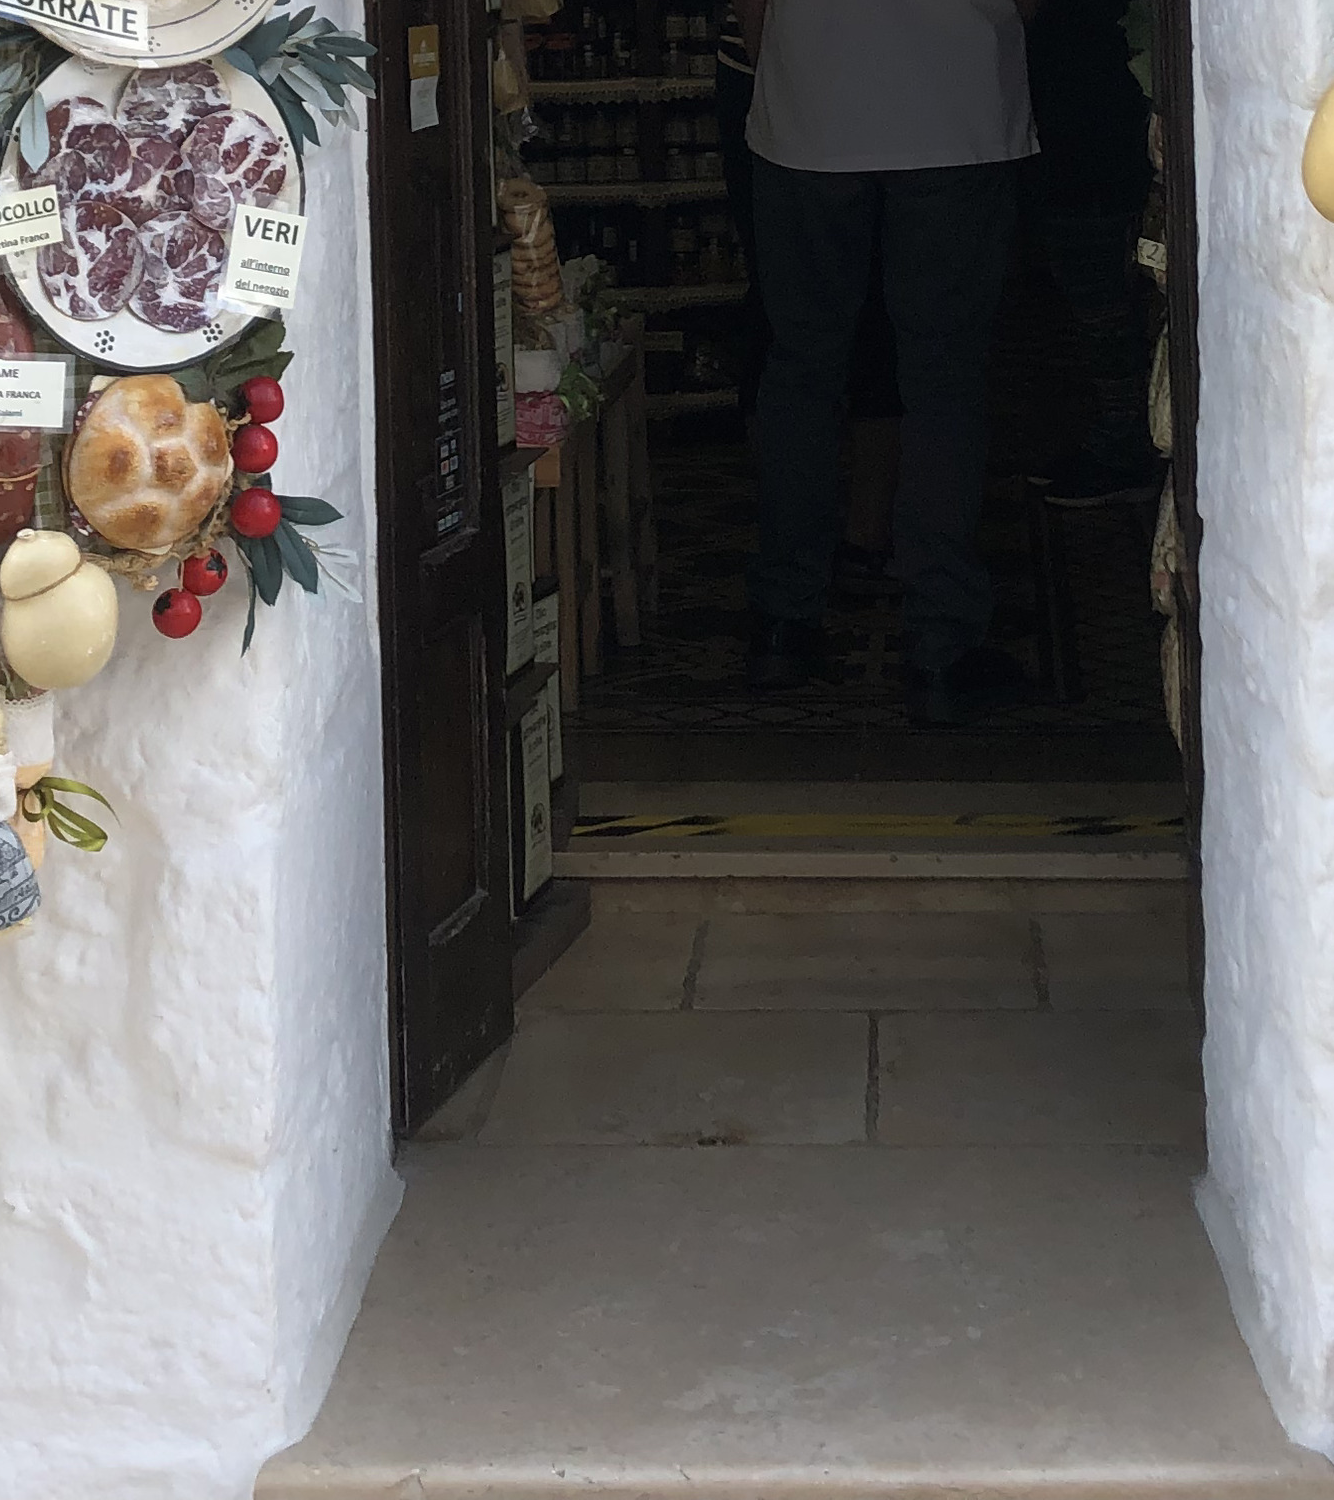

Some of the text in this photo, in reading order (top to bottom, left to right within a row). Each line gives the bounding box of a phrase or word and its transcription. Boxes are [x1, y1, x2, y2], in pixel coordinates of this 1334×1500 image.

[19, 231, 50, 246] Franca
[244, 215, 299, 246] VERI
[241, 258, 290, 276] all'interno
[235, 278, 289, 298] del negozio
[5, 389, 42, 400] FRANCA
